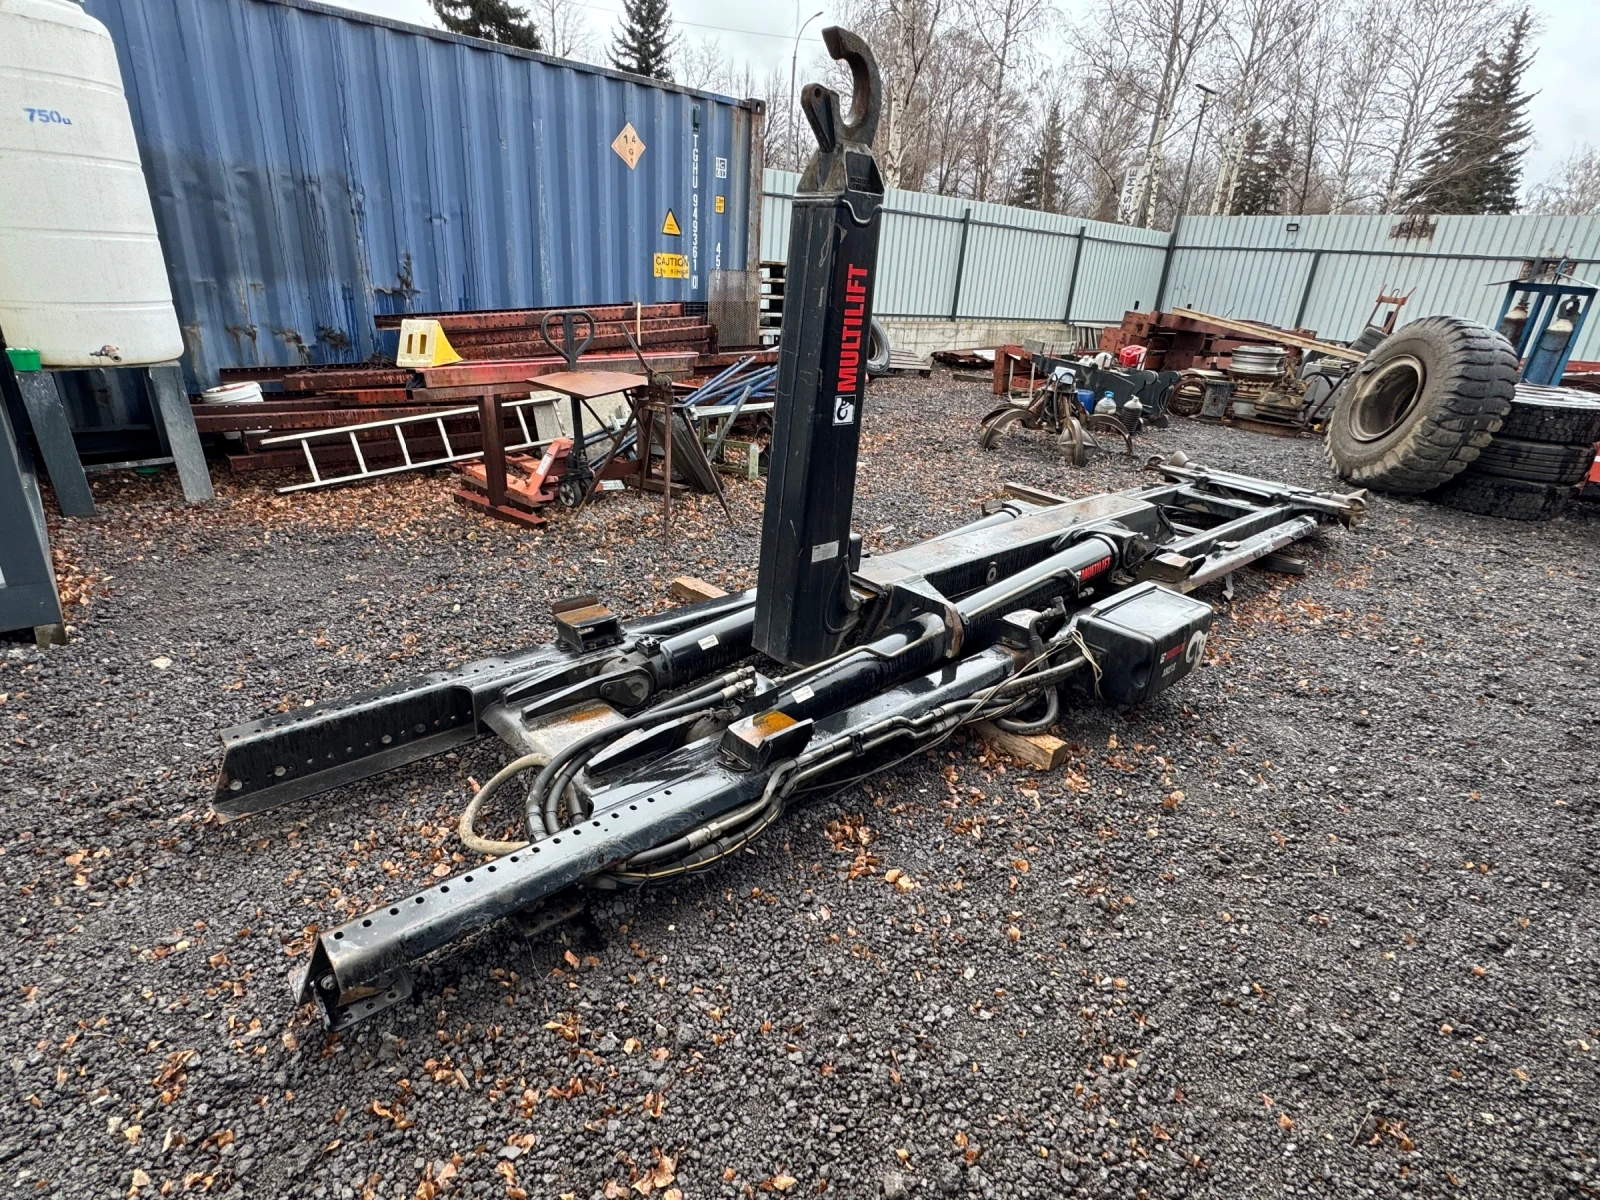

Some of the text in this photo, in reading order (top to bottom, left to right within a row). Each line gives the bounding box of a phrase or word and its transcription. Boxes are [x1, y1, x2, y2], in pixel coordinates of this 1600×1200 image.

[628, 148, 635, 156] G
[655, 256, 689, 267] CAUTION
[837, 263, 868, 392] MULTILIFT
